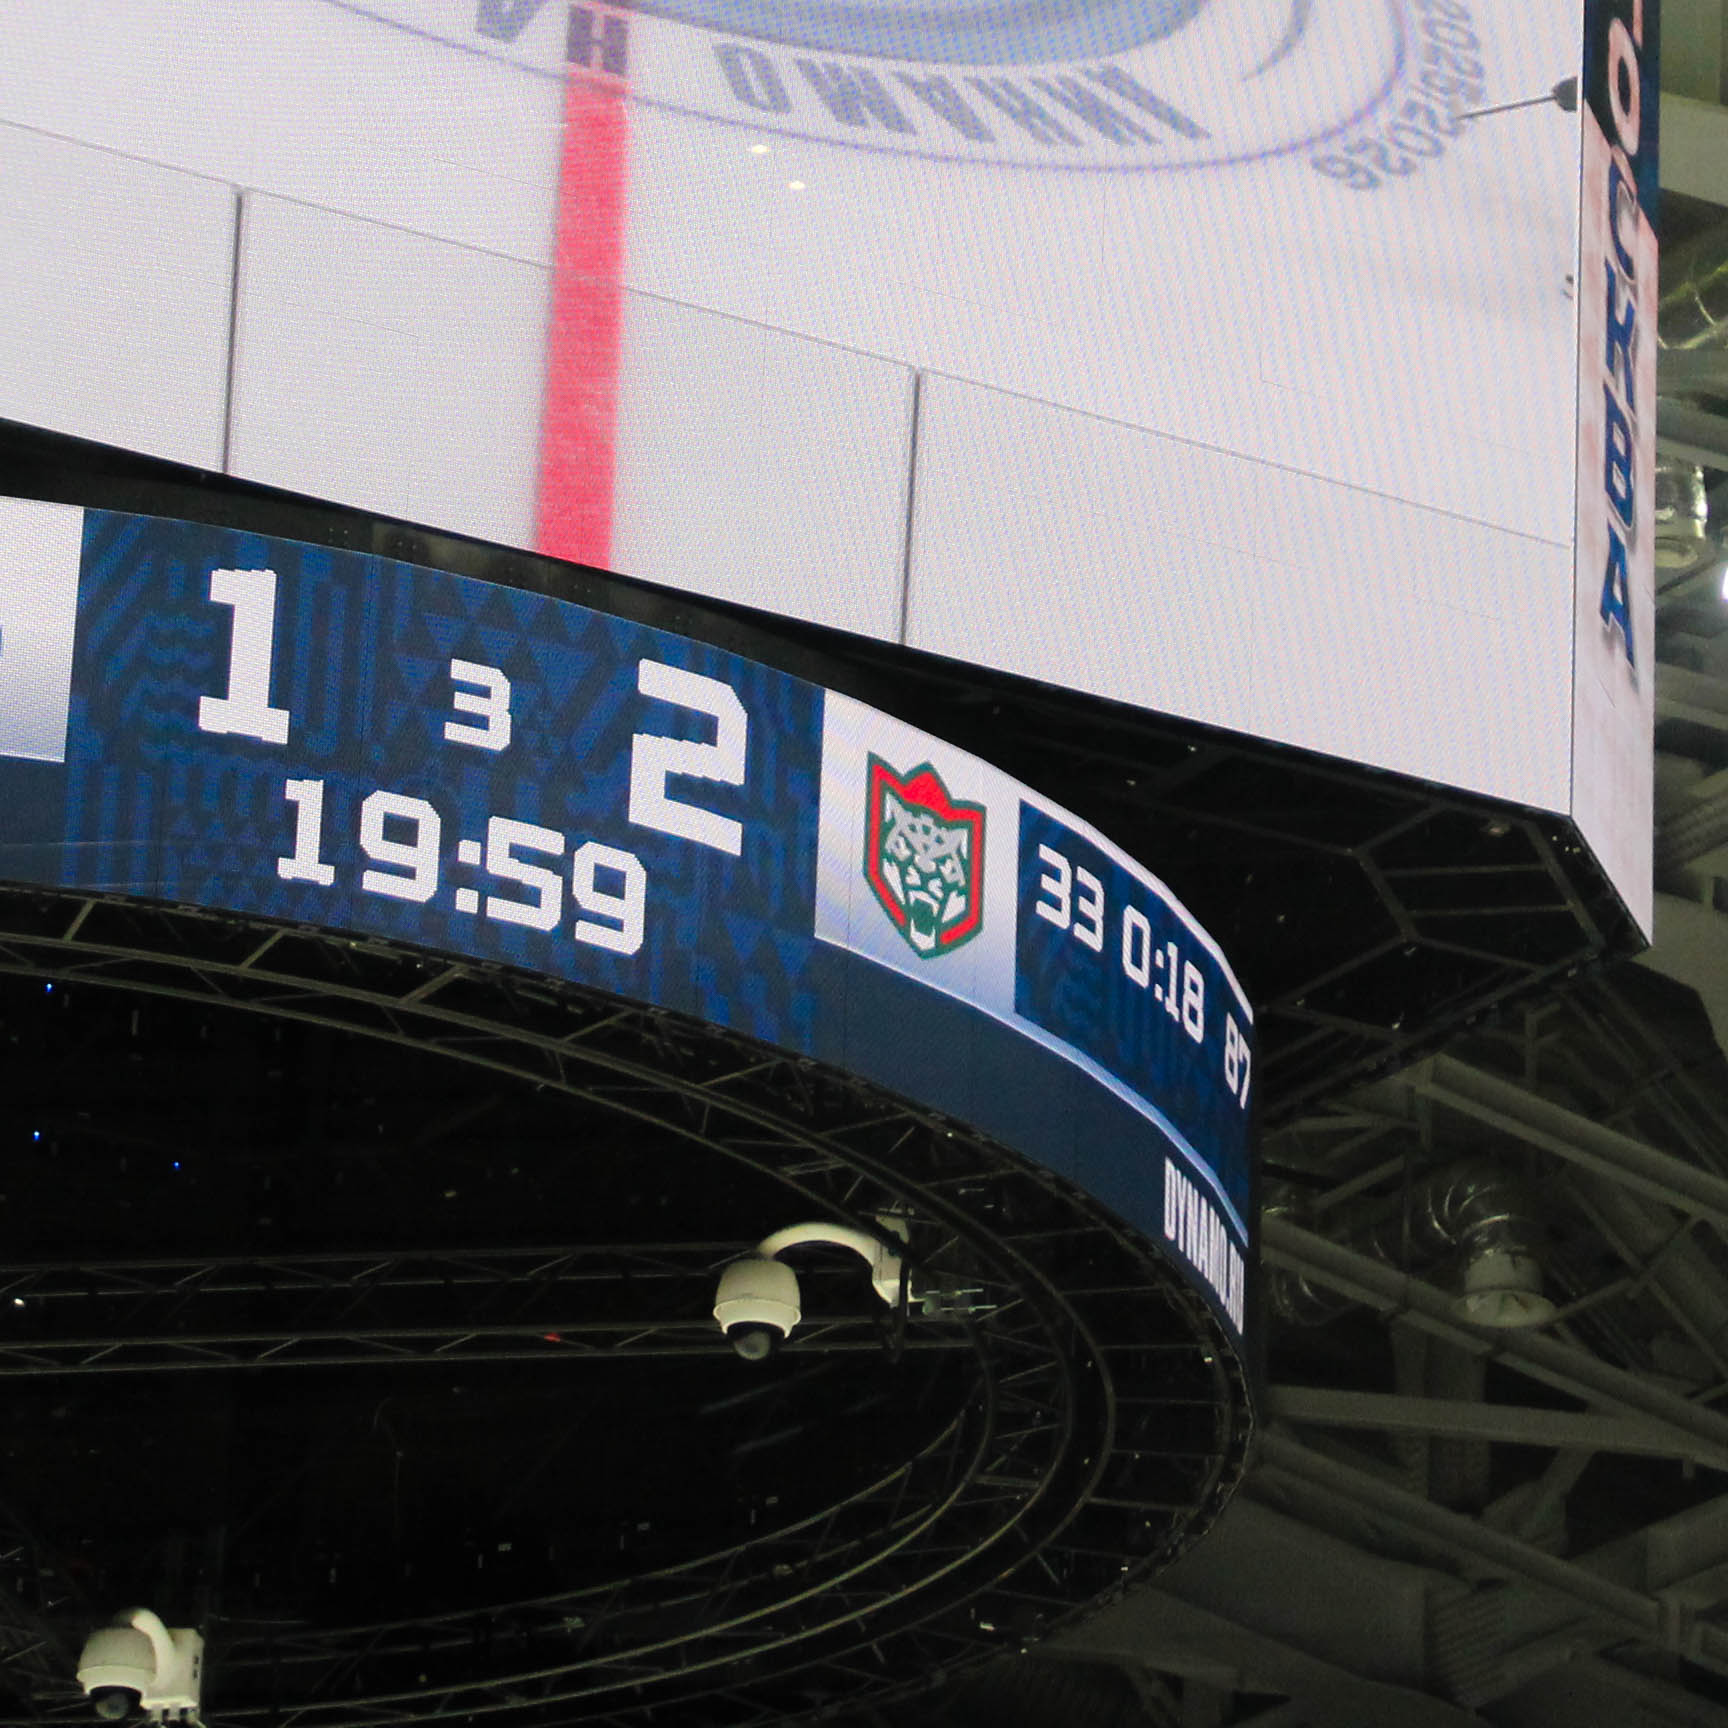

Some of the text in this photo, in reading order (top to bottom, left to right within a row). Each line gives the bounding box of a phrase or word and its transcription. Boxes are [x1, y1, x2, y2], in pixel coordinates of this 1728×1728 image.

[199, 568, 747, 856] 1 3 2
[277, 778, 645, 957] 19:59
[1036, 843, 1252, 1110] 33 0:18 87
[1164, 1156, 1245, 1337] DYNAMO.RU
